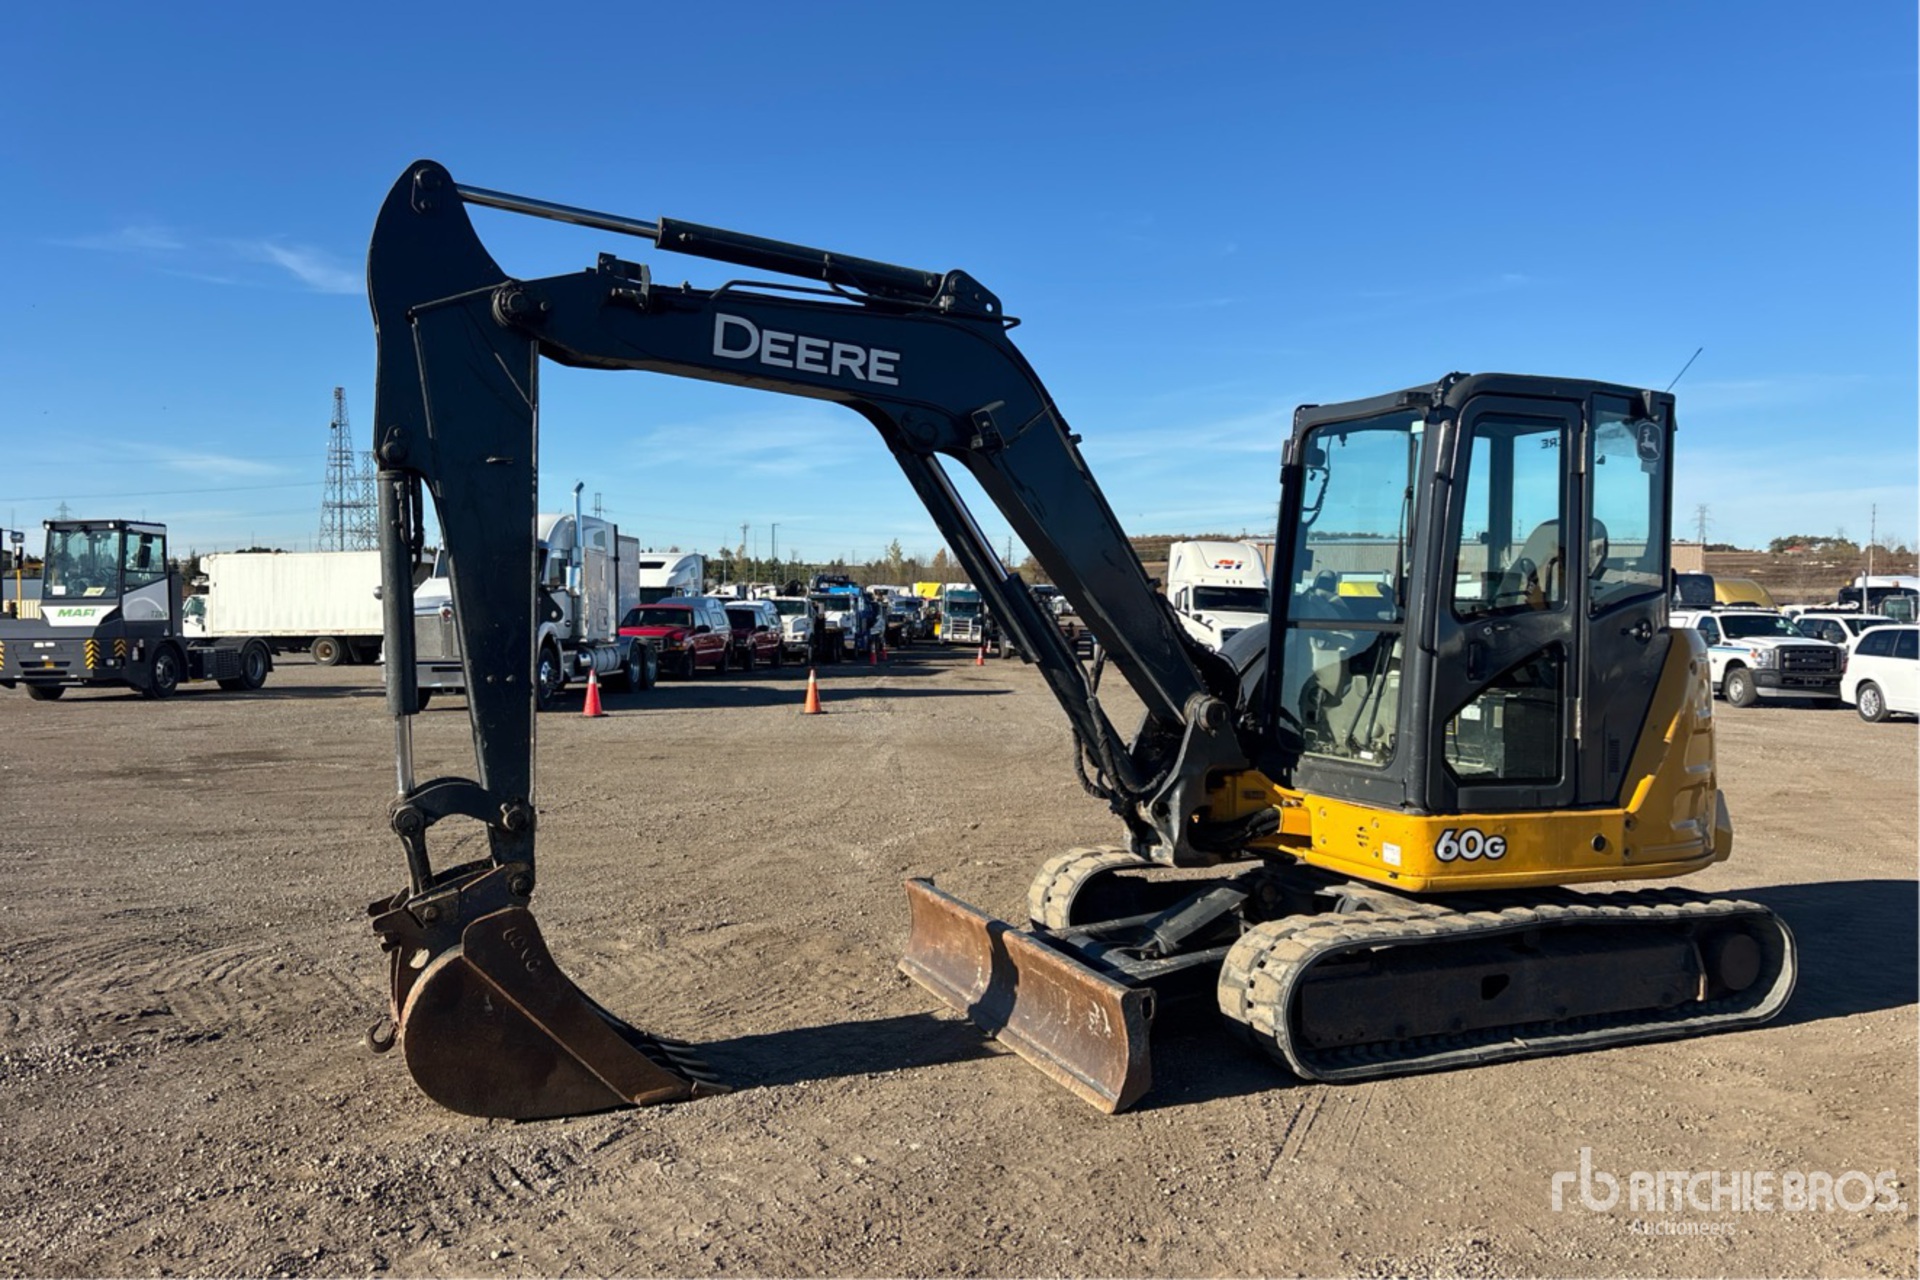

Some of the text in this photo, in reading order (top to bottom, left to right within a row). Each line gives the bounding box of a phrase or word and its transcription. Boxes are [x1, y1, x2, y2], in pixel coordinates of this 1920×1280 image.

[712, 312, 900, 386] DEERE
[57, 608, 96, 617] MAFI
[1435, 828, 1506, 862] 60G
